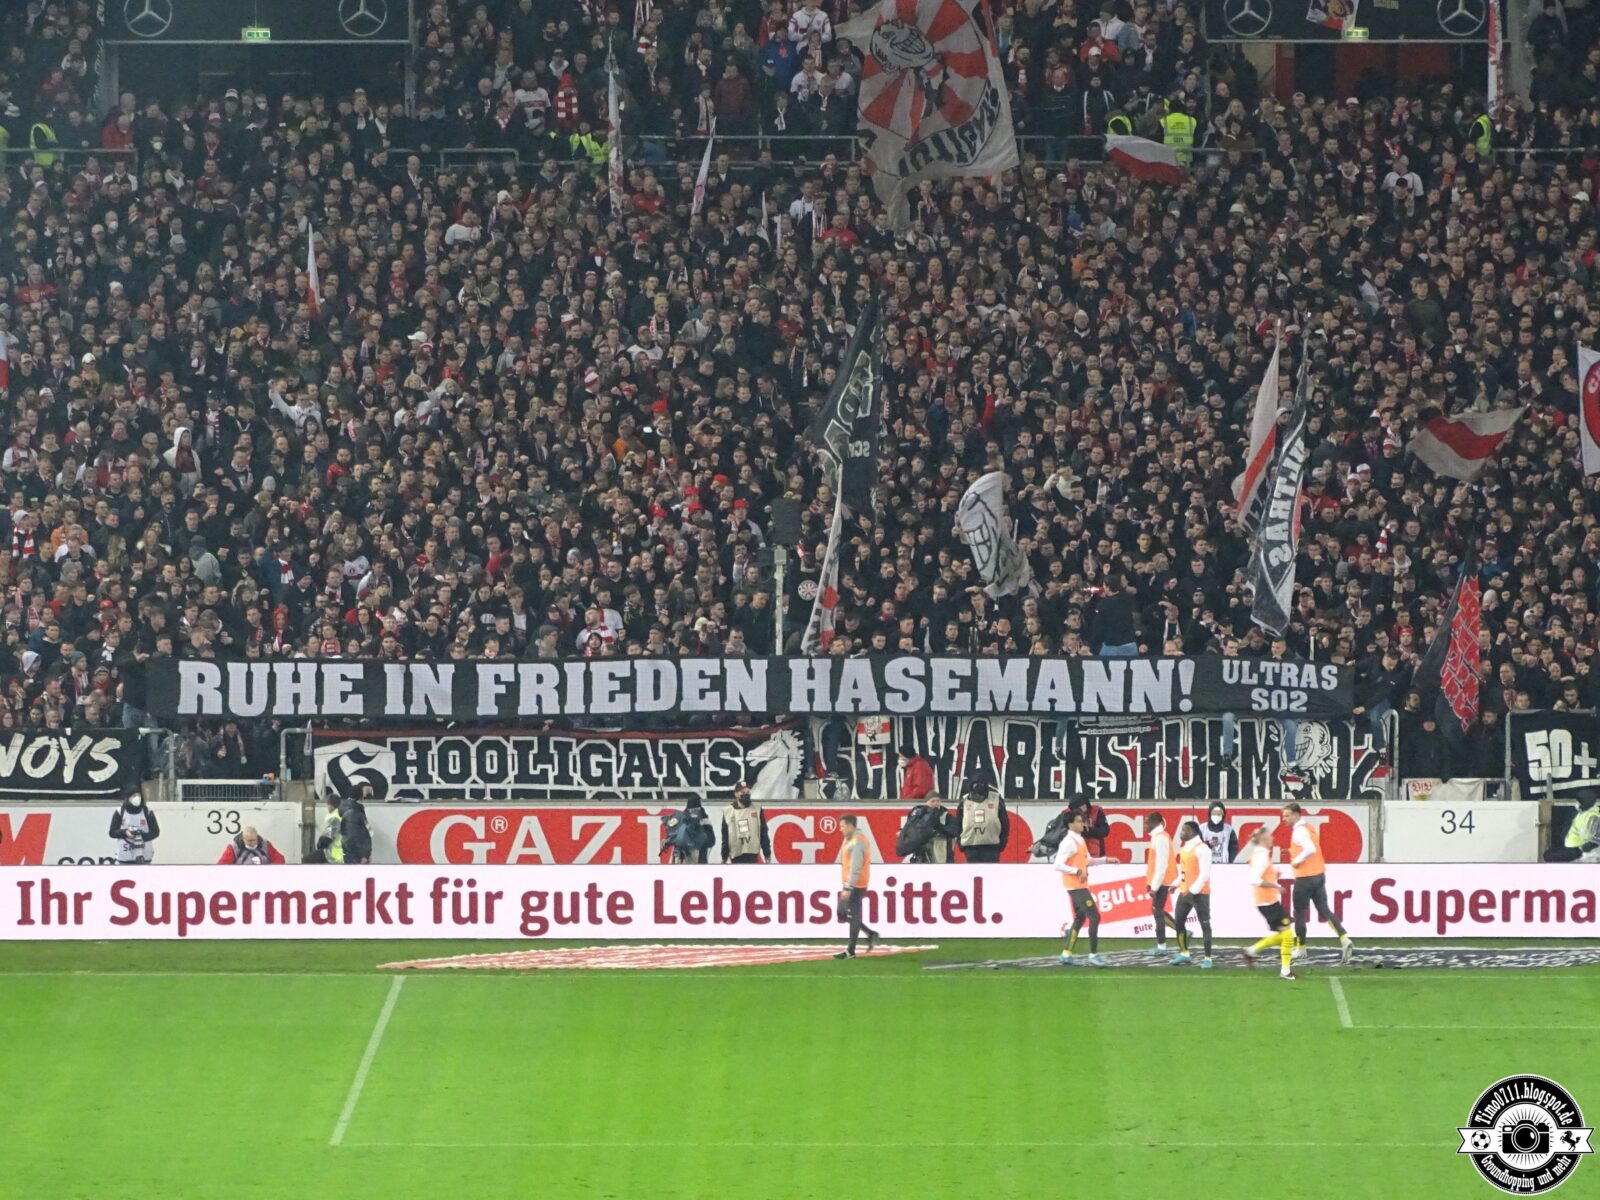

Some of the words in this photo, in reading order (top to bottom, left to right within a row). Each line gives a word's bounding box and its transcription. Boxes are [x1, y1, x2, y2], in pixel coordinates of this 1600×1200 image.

[178, 661, 364, 716] RUHE
[384, 663, 455, 716] IN
[476, 658, 768, 715] FRIEDEN
[789, 656, 1195, 713] HASEMANN!
[1222, 659, 1338, 690] ULTRAS
[386, 736, 745, 786] HOOLIGANS
[207, 810, 241, 835] 33
[973, 826, 986, 835] TV
[1440, 810, 1475, 834] 34
[17, 879, 92, 925] Ihr
[110, 878, 413, 937] Supermarkt
[430, 877, 503, 925] für
[519, 882, 634, 937] gute
